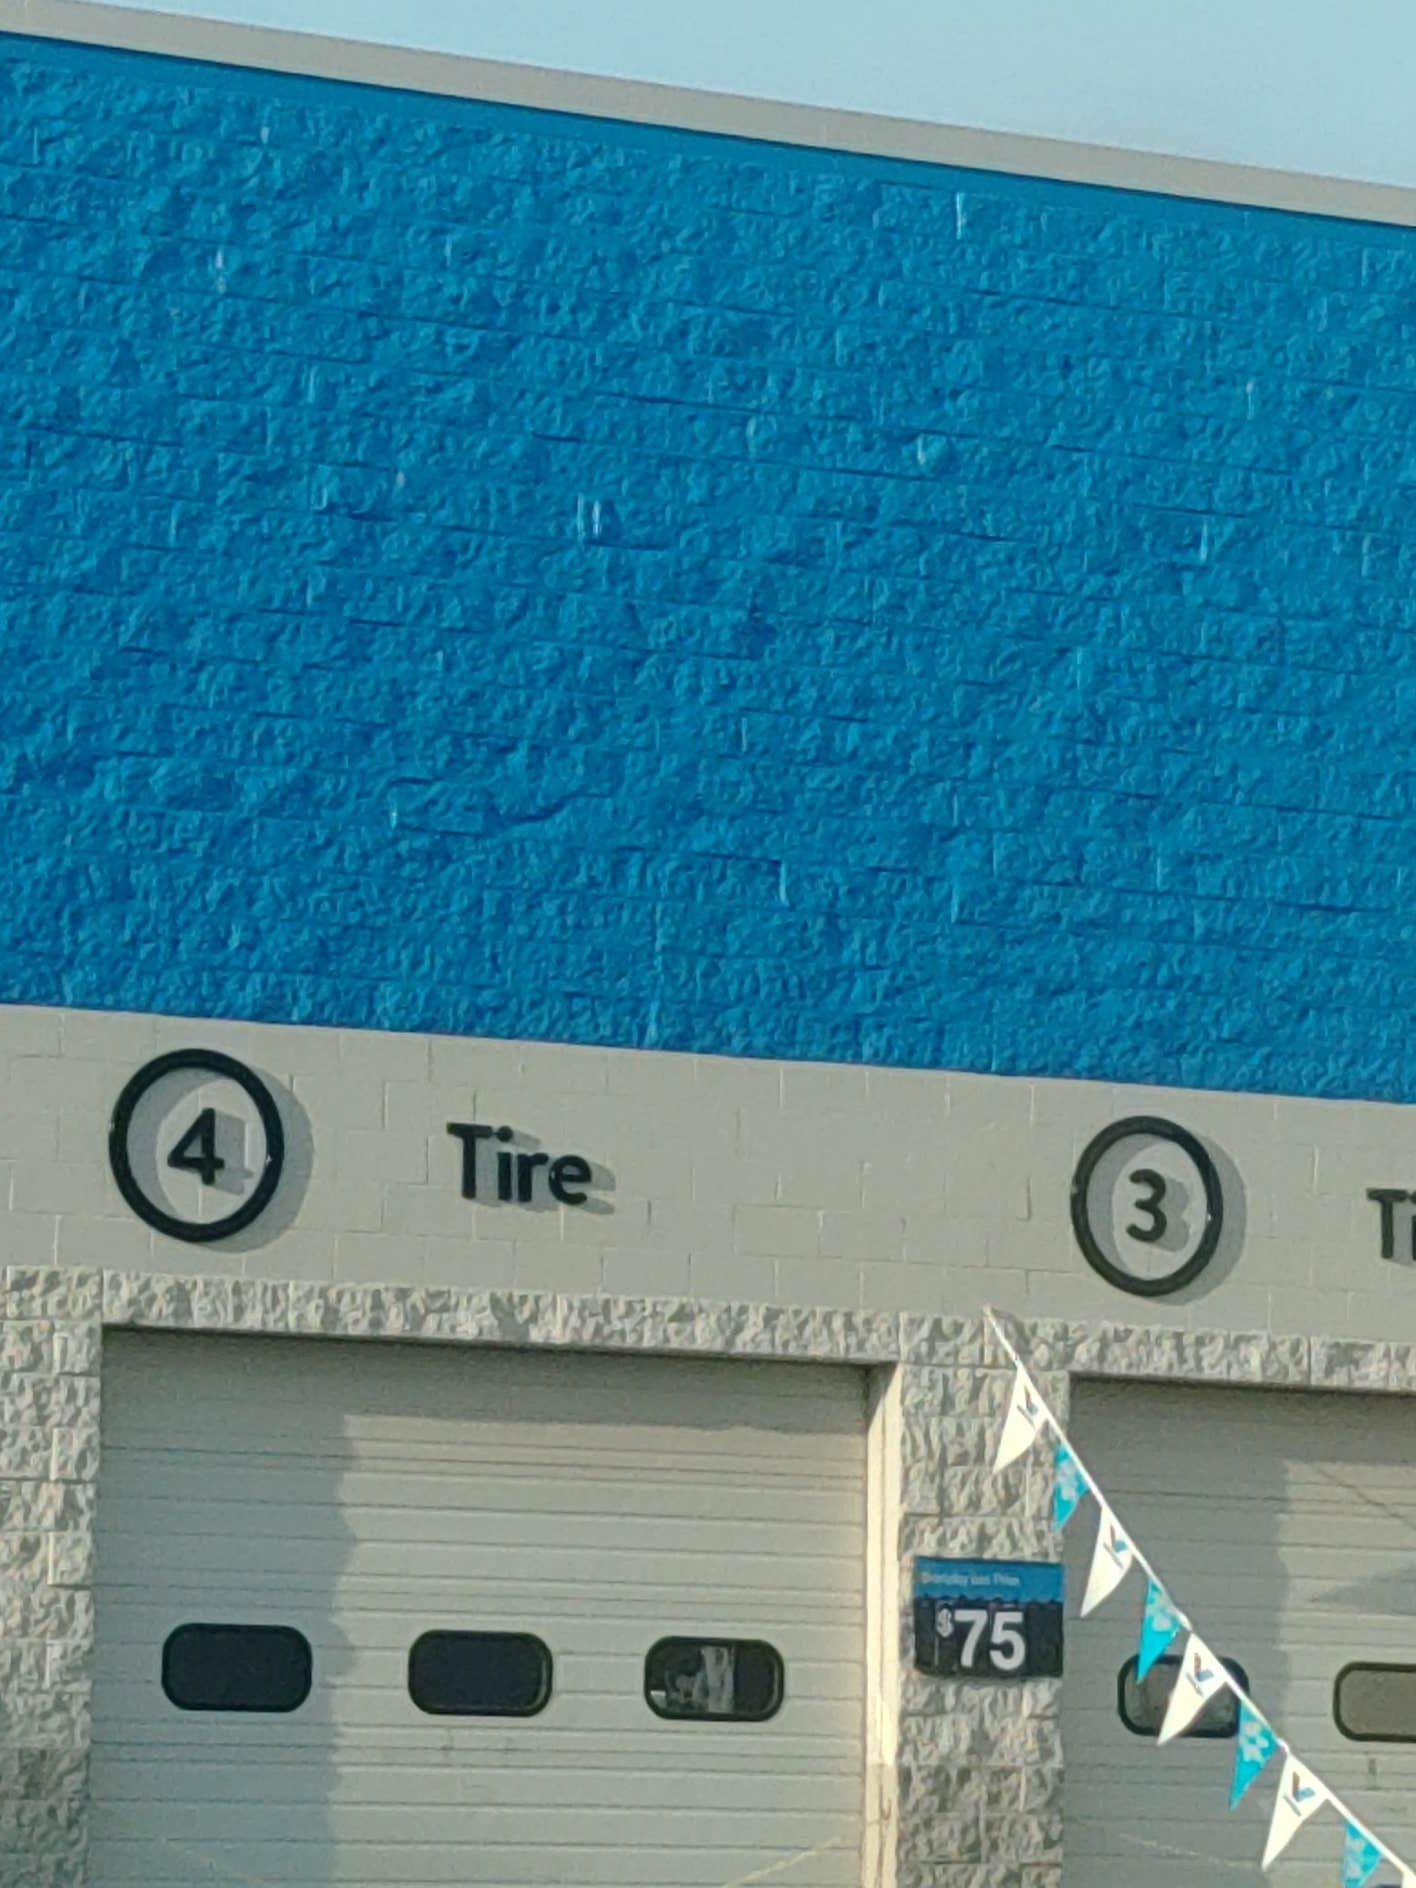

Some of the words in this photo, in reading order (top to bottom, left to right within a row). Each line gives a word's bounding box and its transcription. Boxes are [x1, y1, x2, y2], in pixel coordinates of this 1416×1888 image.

[167, 1108, 225, 1186] 4
[446, 1121, 593, 1205] Tire
[1125, 1168, 1167, 1244] 3
[936, 1608, 1026, 1671] $75
